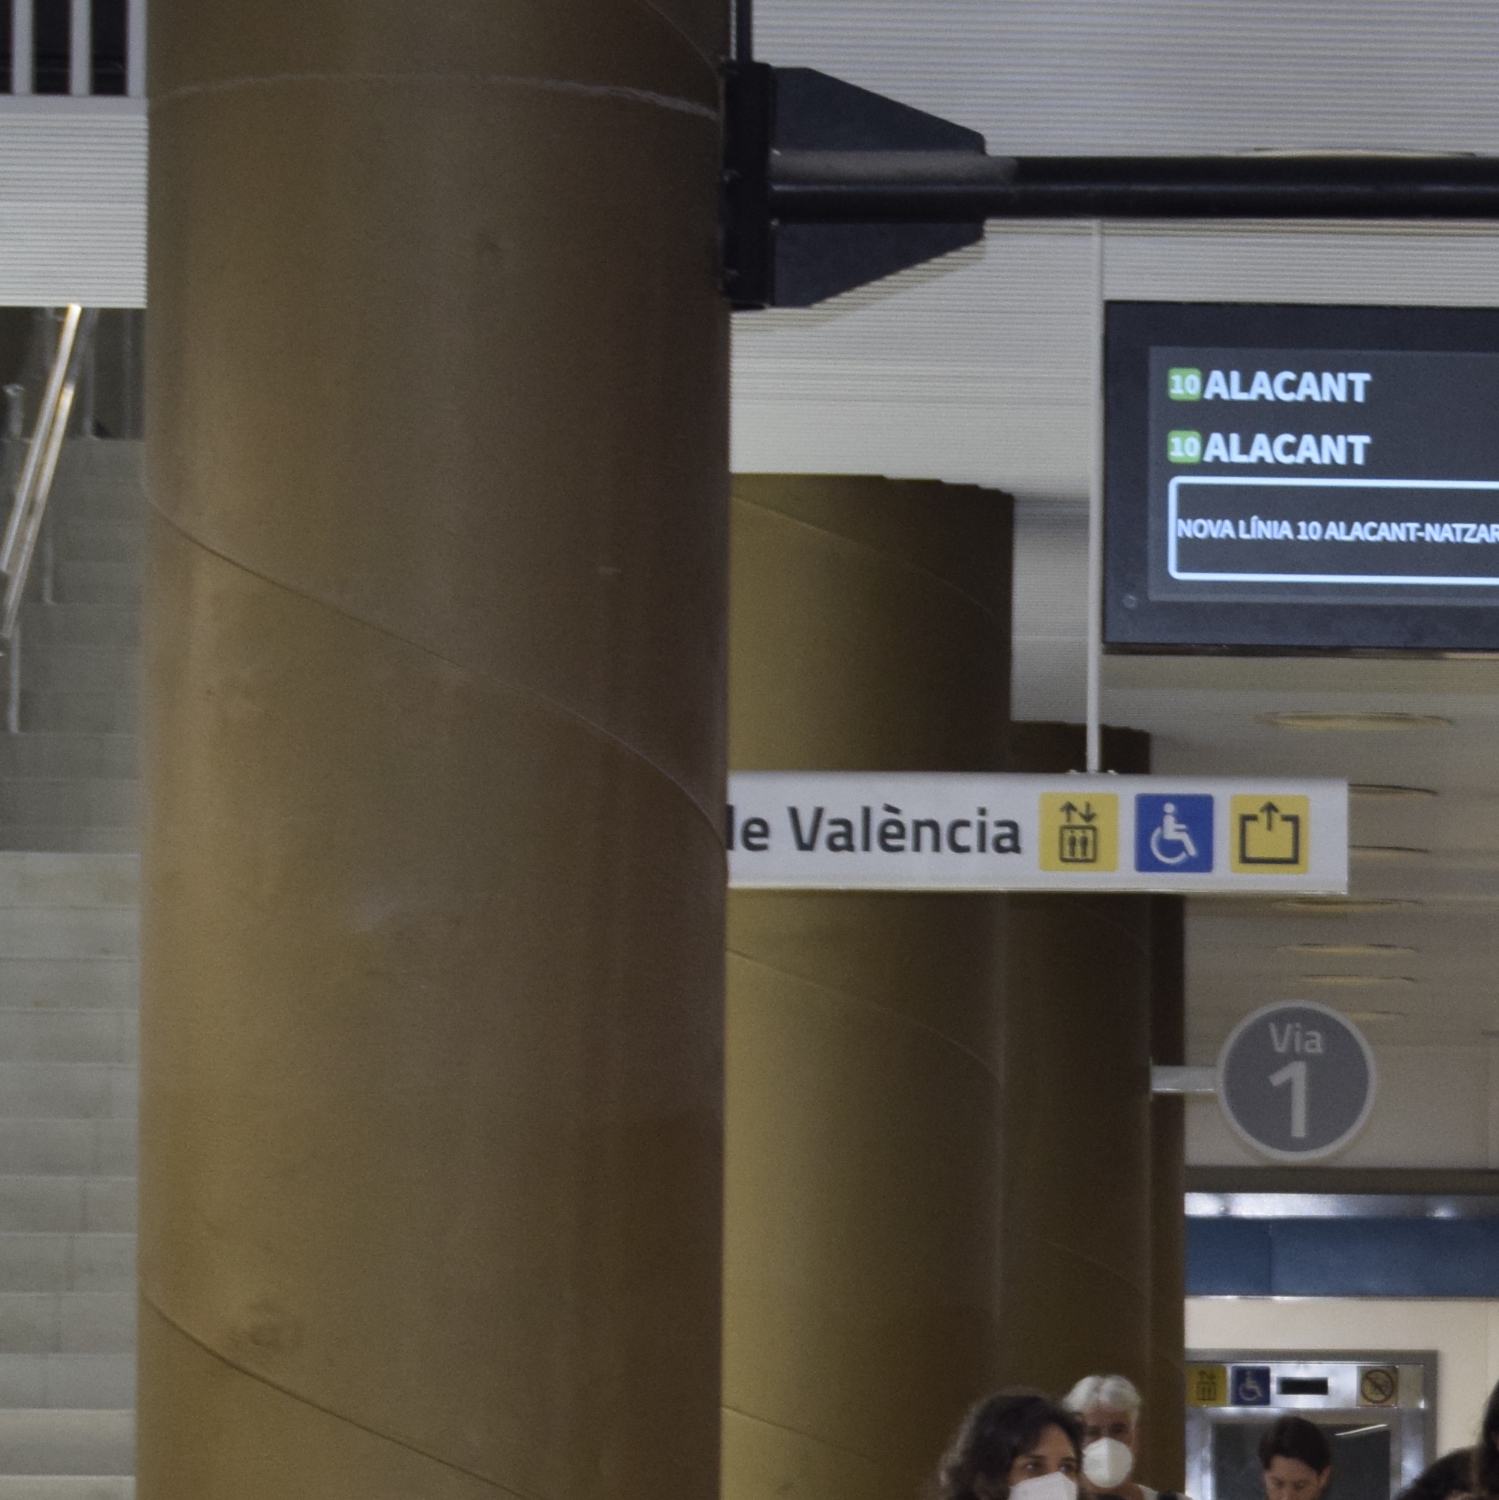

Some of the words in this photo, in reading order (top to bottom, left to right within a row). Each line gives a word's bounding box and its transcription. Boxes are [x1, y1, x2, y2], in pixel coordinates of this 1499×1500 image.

[1170, 374, 1201, 396] 10
[1203, 369, 1372, 403] ALACANT
[1169, 436, 1201, 458] 10
[1203, 431, 1372, 465] ALACANT
[1177, 518, 1236, 540] NOVA
[1238, 515, 1294, 541] LÍNIA
[1297, 520, 1323, 541] 10
[788, 803, 1022, 855] València
[1269, 1021, 1324, 1055] Via
[1266, 1060, 1309, 1140] 1
